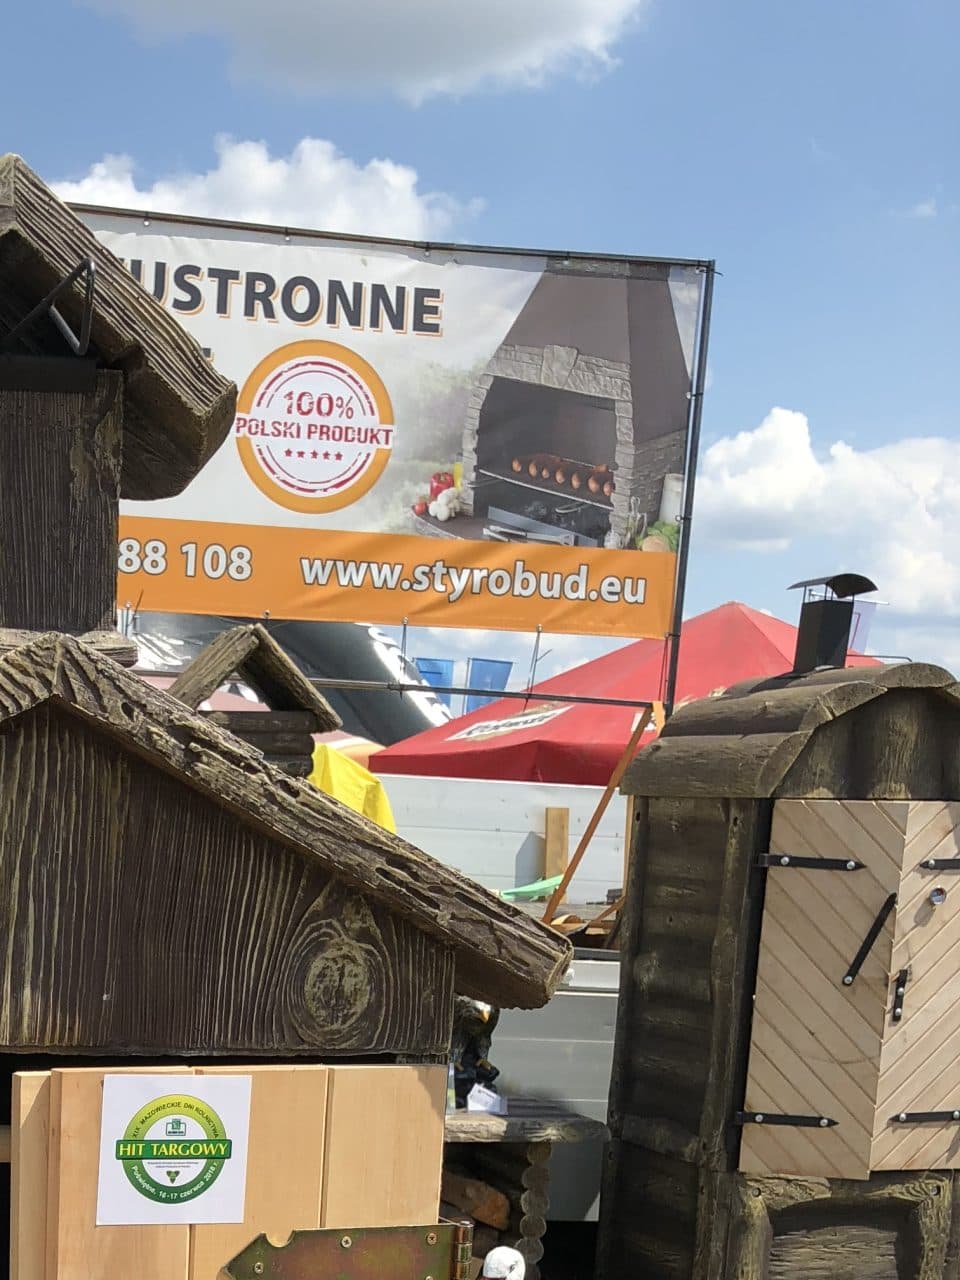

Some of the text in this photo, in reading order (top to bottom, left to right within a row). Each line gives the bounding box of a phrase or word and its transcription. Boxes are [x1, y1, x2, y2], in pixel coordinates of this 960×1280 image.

[128, 257, 442, 334] USTRONNE
[283, 390, 354, 420] 100%
[235, 416, 394, 446] POLSKI PRODUKT
[118, 537, 647, 604] 88 108 www.styrobud.eu
[119, 1143, 228, 1156] HIT TARGOWY
